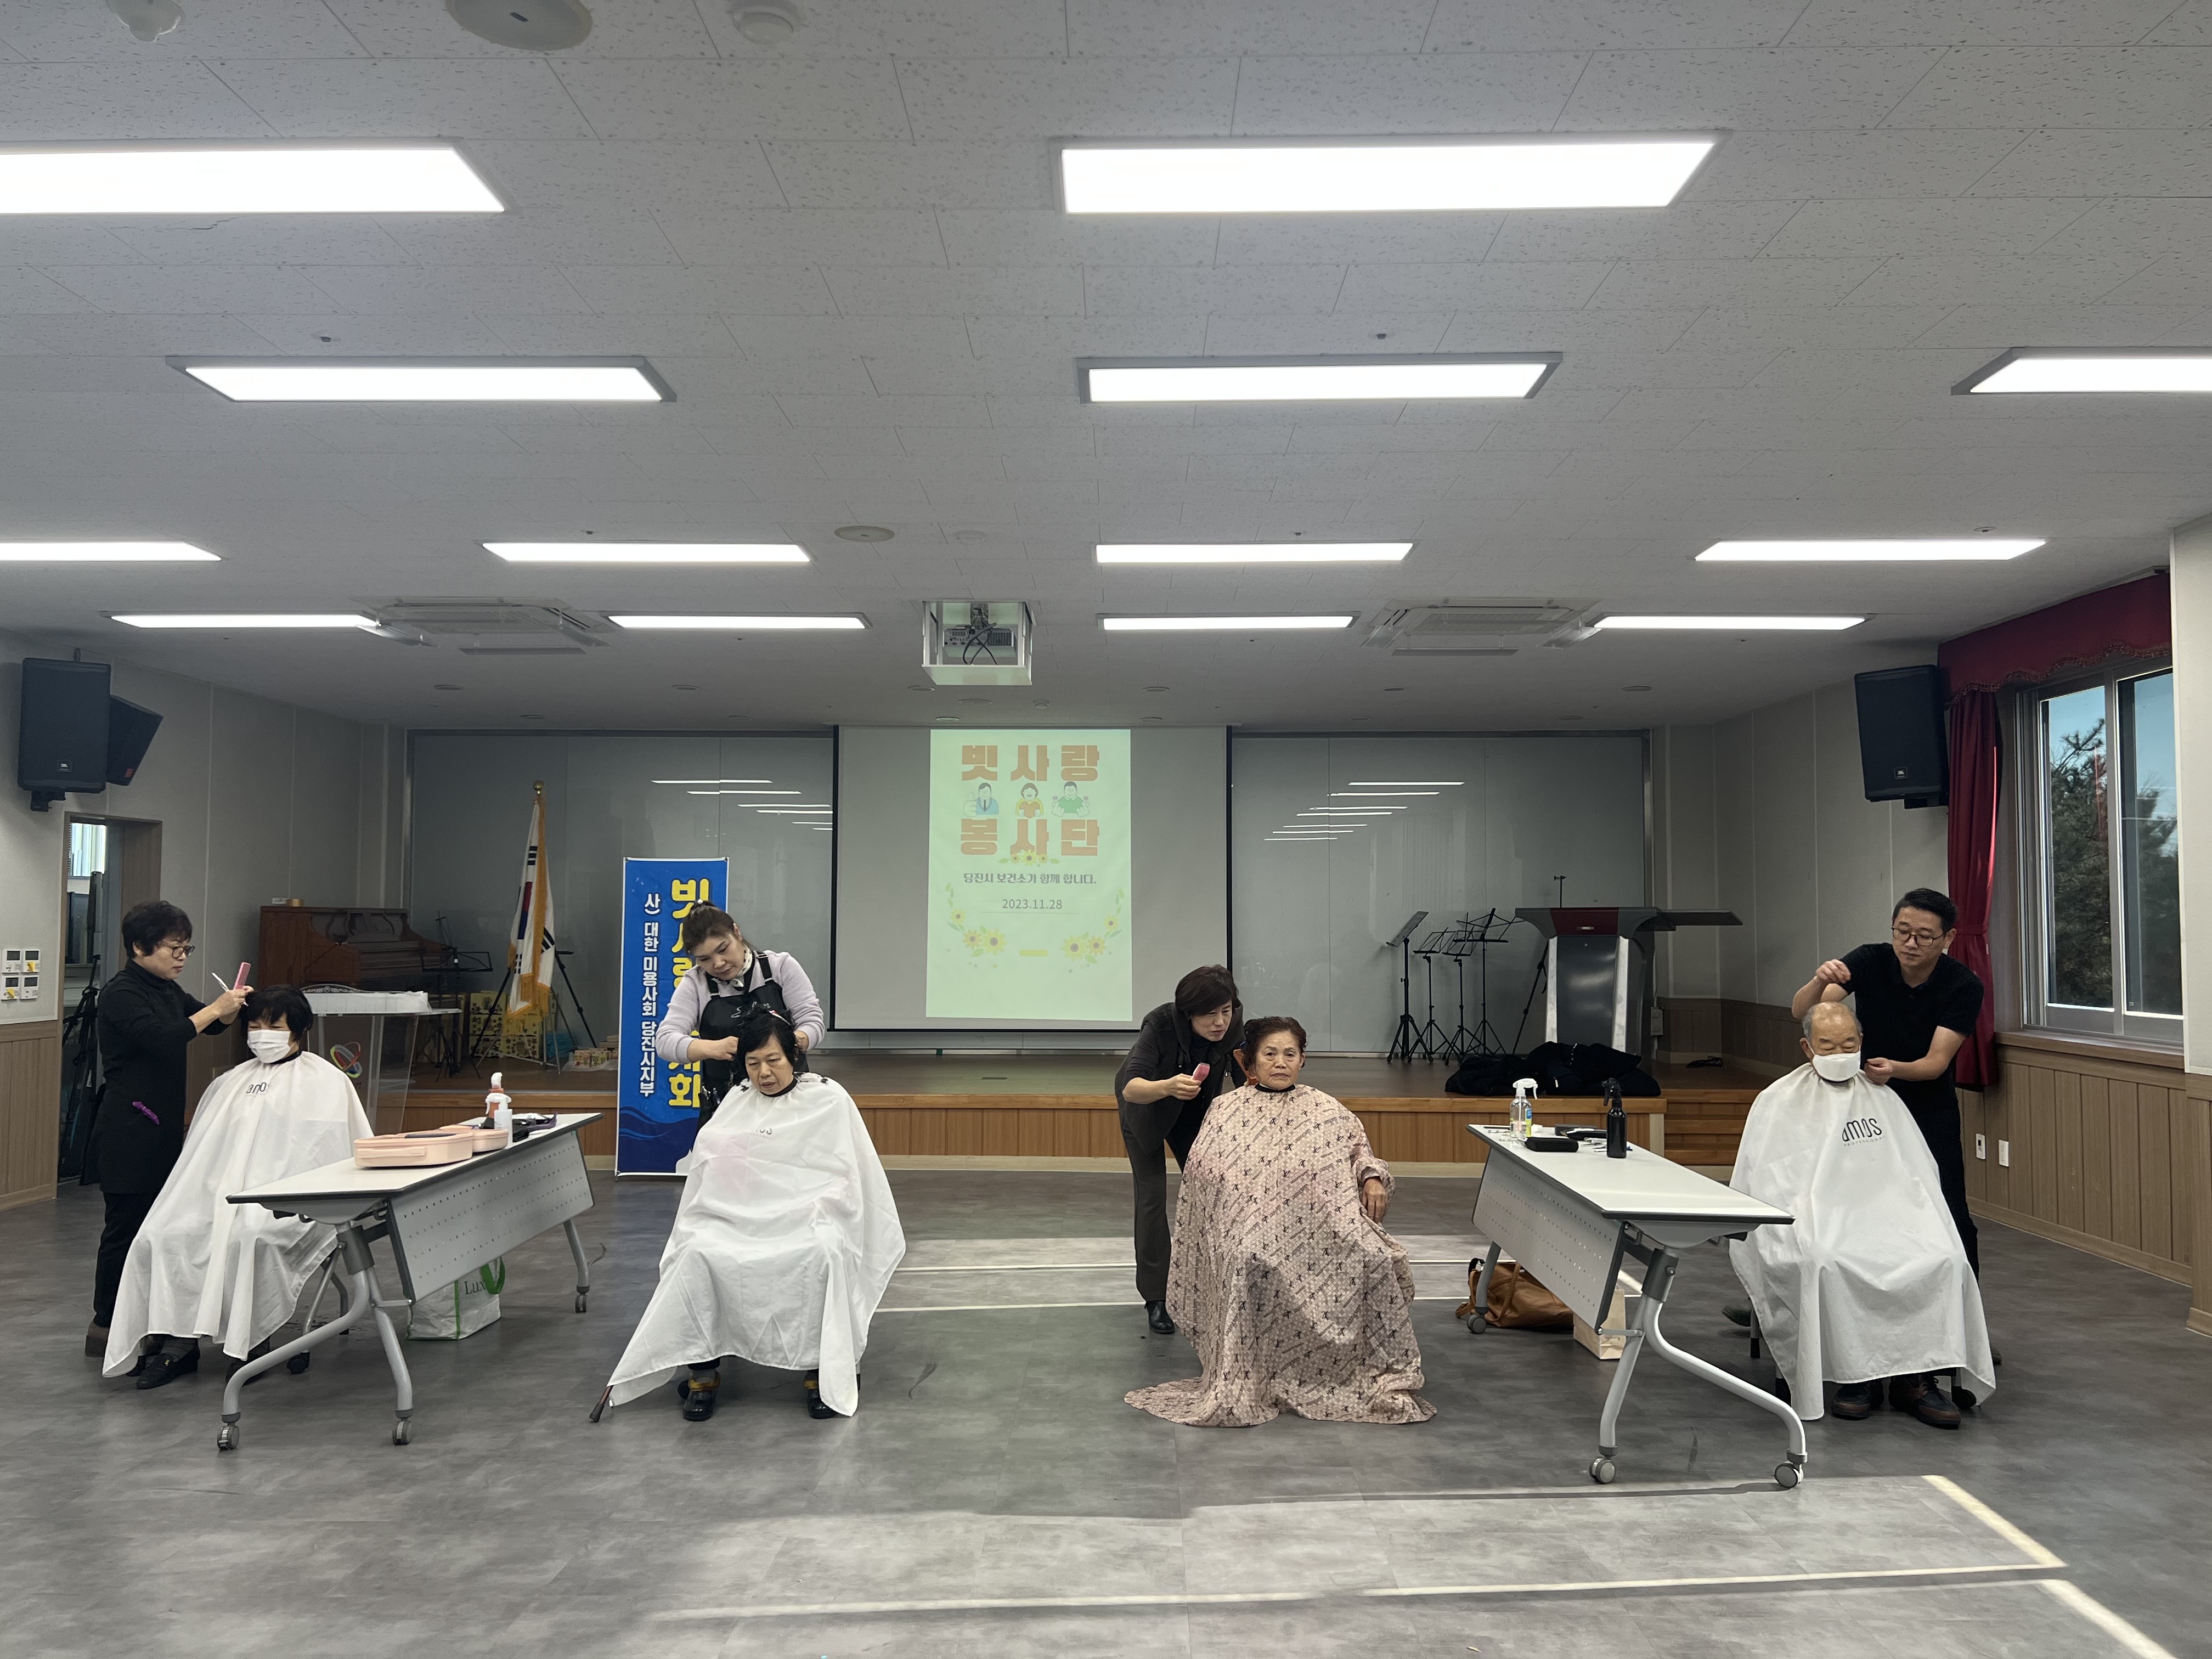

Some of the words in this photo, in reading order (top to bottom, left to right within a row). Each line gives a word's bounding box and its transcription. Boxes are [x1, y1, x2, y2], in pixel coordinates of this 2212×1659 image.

[961, 819, 1100, 856] 봉사단
[963, 873, 994, 883] 당진시
[997, 873, 1037, 884] 보건소가
[1040, 873, 1060, 884] 함께
[1063, 873, 1097, 884] 합니다.
[1002, 899, 1063, 910] 2023.11.28
[644, 922, 659, 952] 대한
[642, 956, 658, 1017] 미용사회
[639, 1021, 657, 1097] 당진시지부
